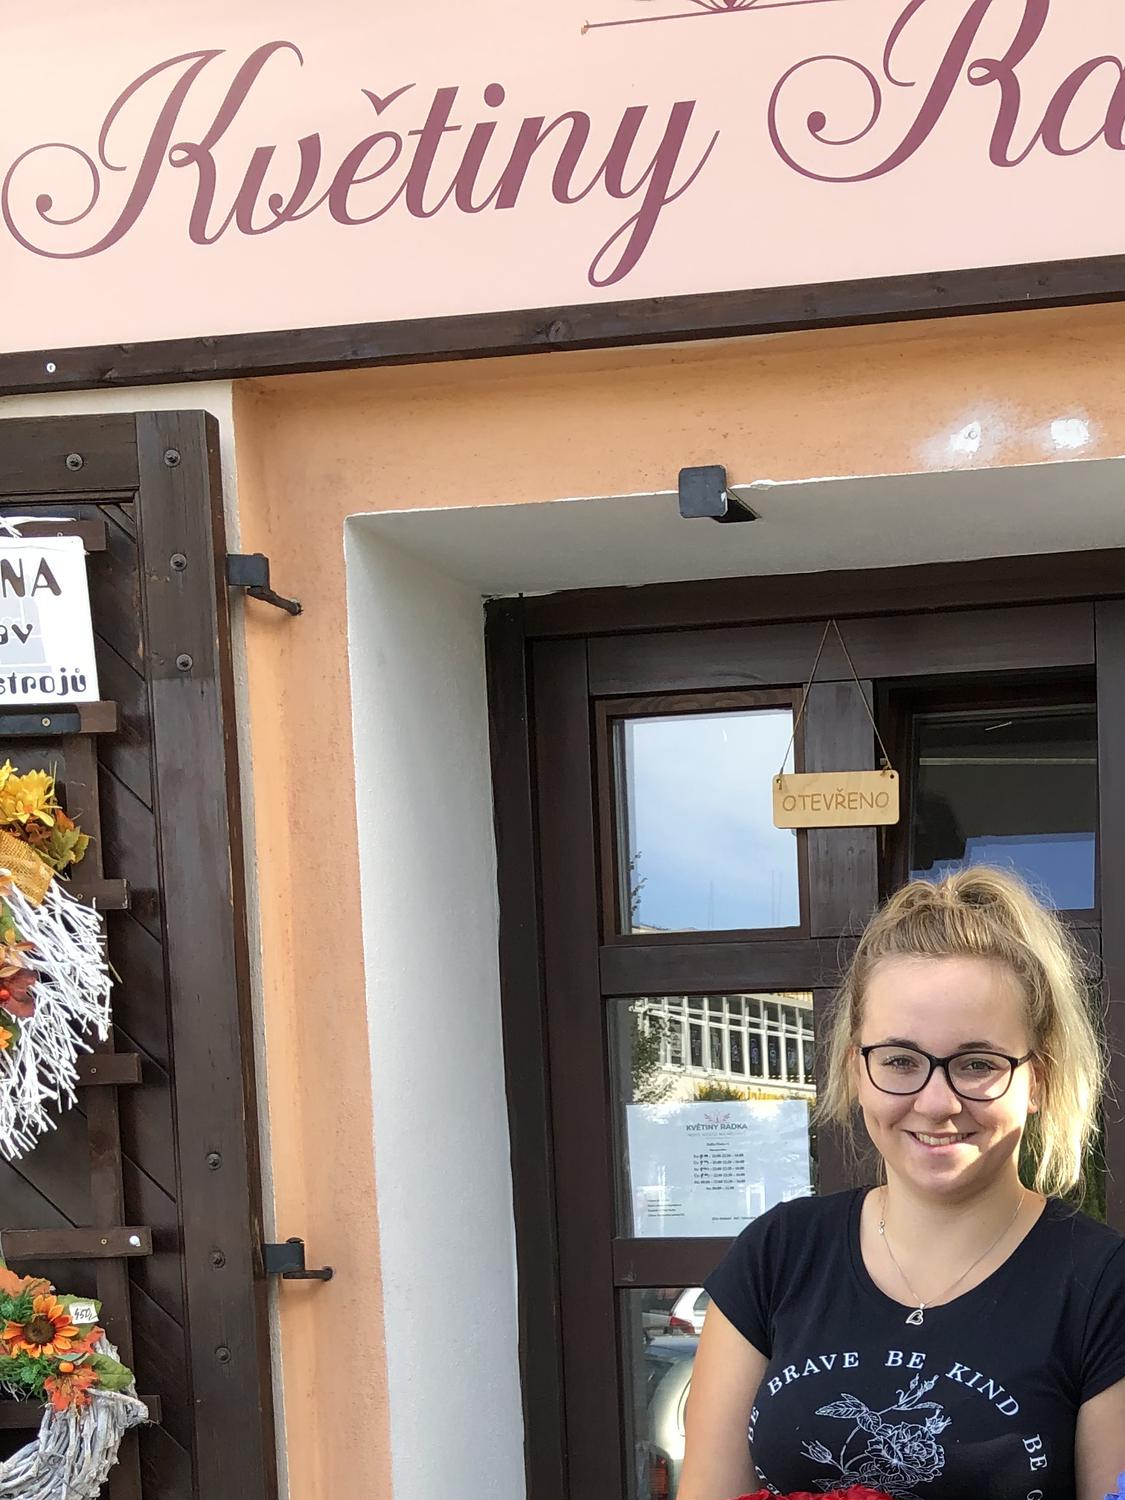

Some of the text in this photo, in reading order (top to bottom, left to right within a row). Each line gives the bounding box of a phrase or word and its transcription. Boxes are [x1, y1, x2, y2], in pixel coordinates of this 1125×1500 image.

[2, 40, 720, 288] Květiny
[782, 787, 890, 812] OTEVŘENO
[767, 1352, 860, 1397] BRAVE
[885, 1350, 927, 1370] BE
[945, 1361, 1021, 1418] KIND
[1022, 1433, 1049, 1472] BE
